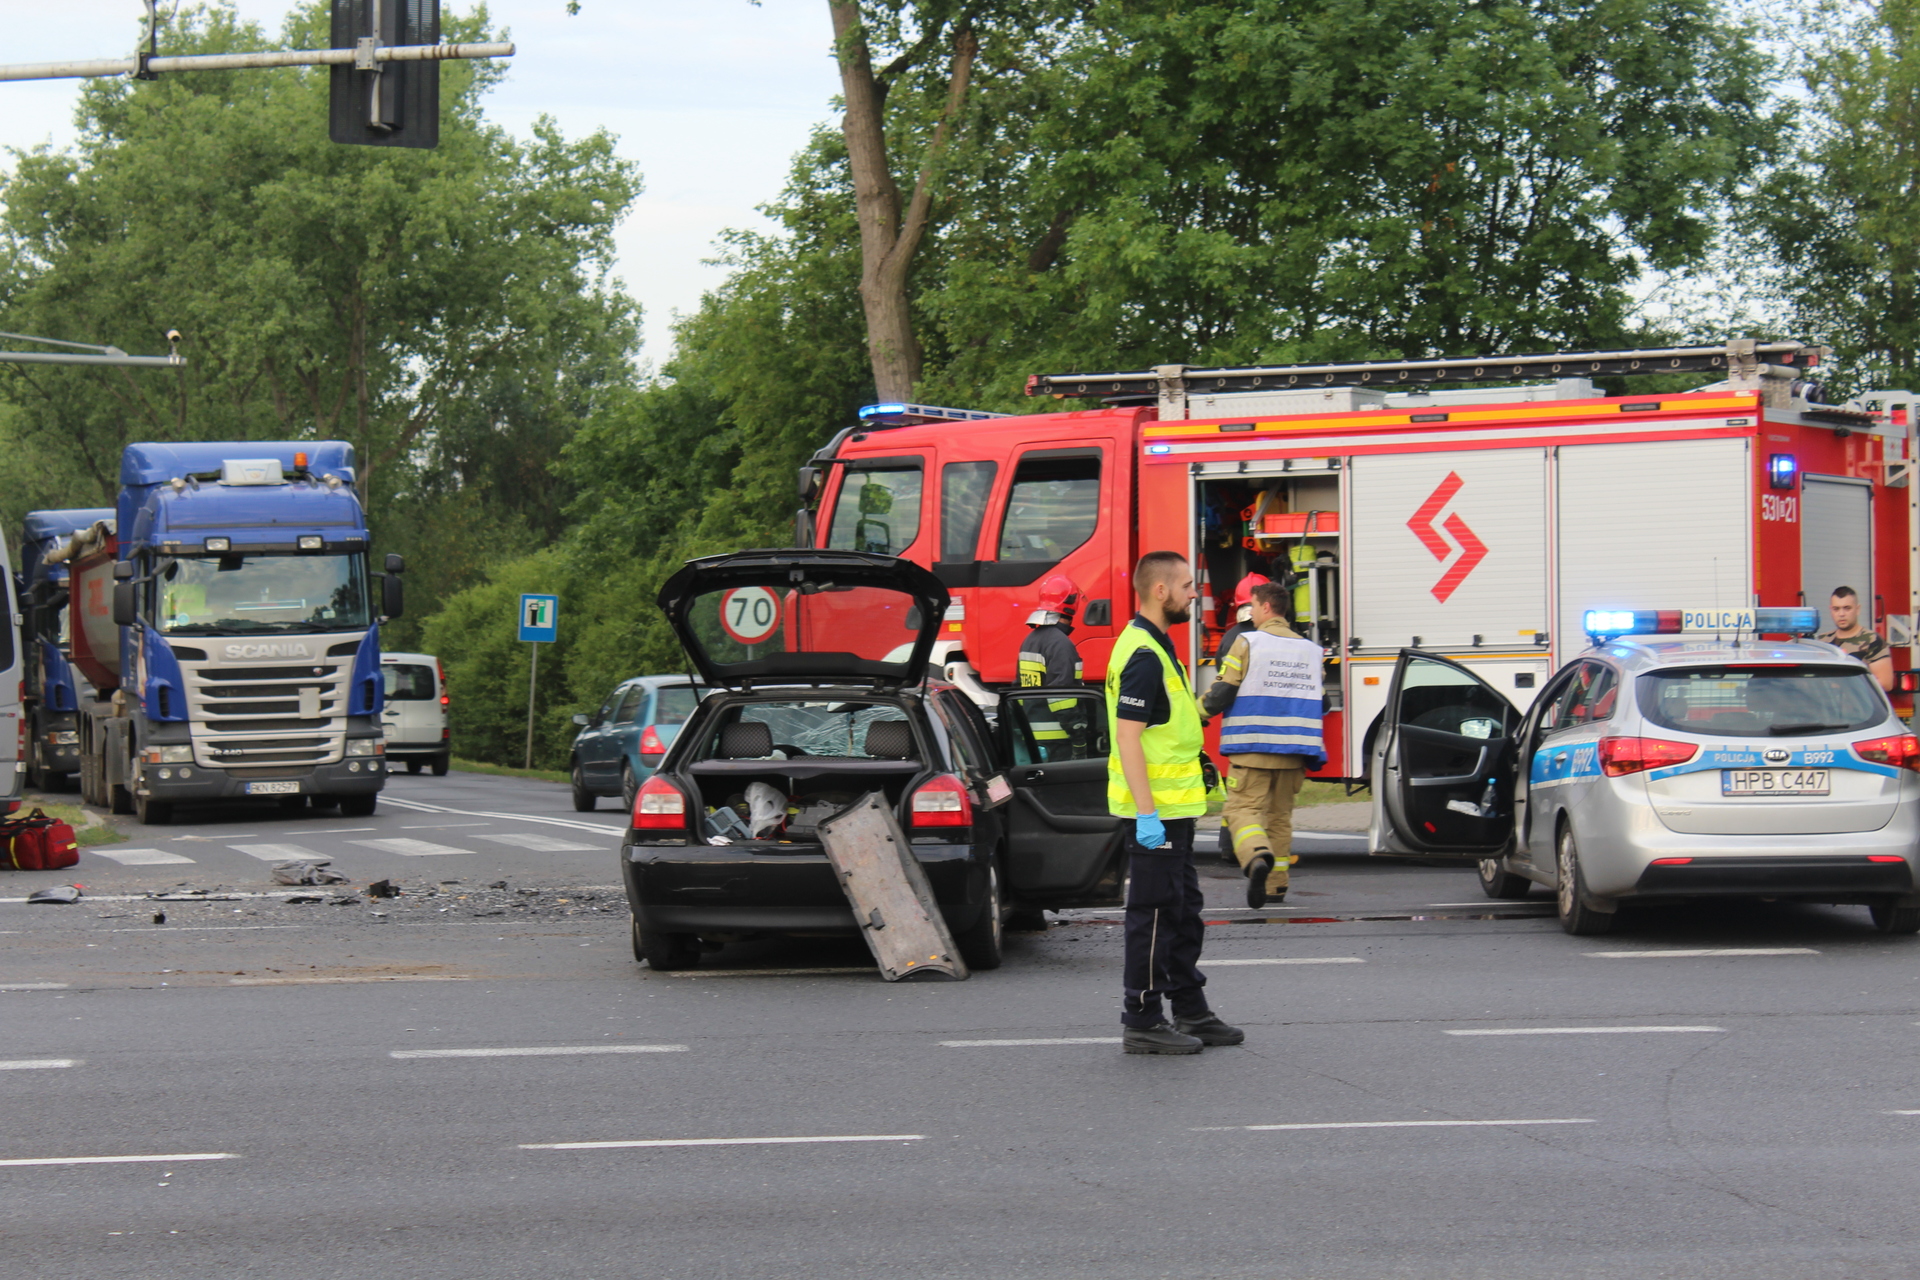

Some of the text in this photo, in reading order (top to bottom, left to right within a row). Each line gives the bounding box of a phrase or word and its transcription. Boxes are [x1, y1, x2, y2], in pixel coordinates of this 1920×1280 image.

[732, 597, 772, 627] 70
[1684, 612, 1753, 629] POLICJA
[225, 643, 309, 659] SCANIA
[1119, 695, 1146, 708] POLICJA
[1714, 752, 1756, 763] POLICJA
[1767, 751, 1787, 759] KIA
[1804, 752, 1835, 764] B992
[1735, 772, 1826, 790] HPB C447
